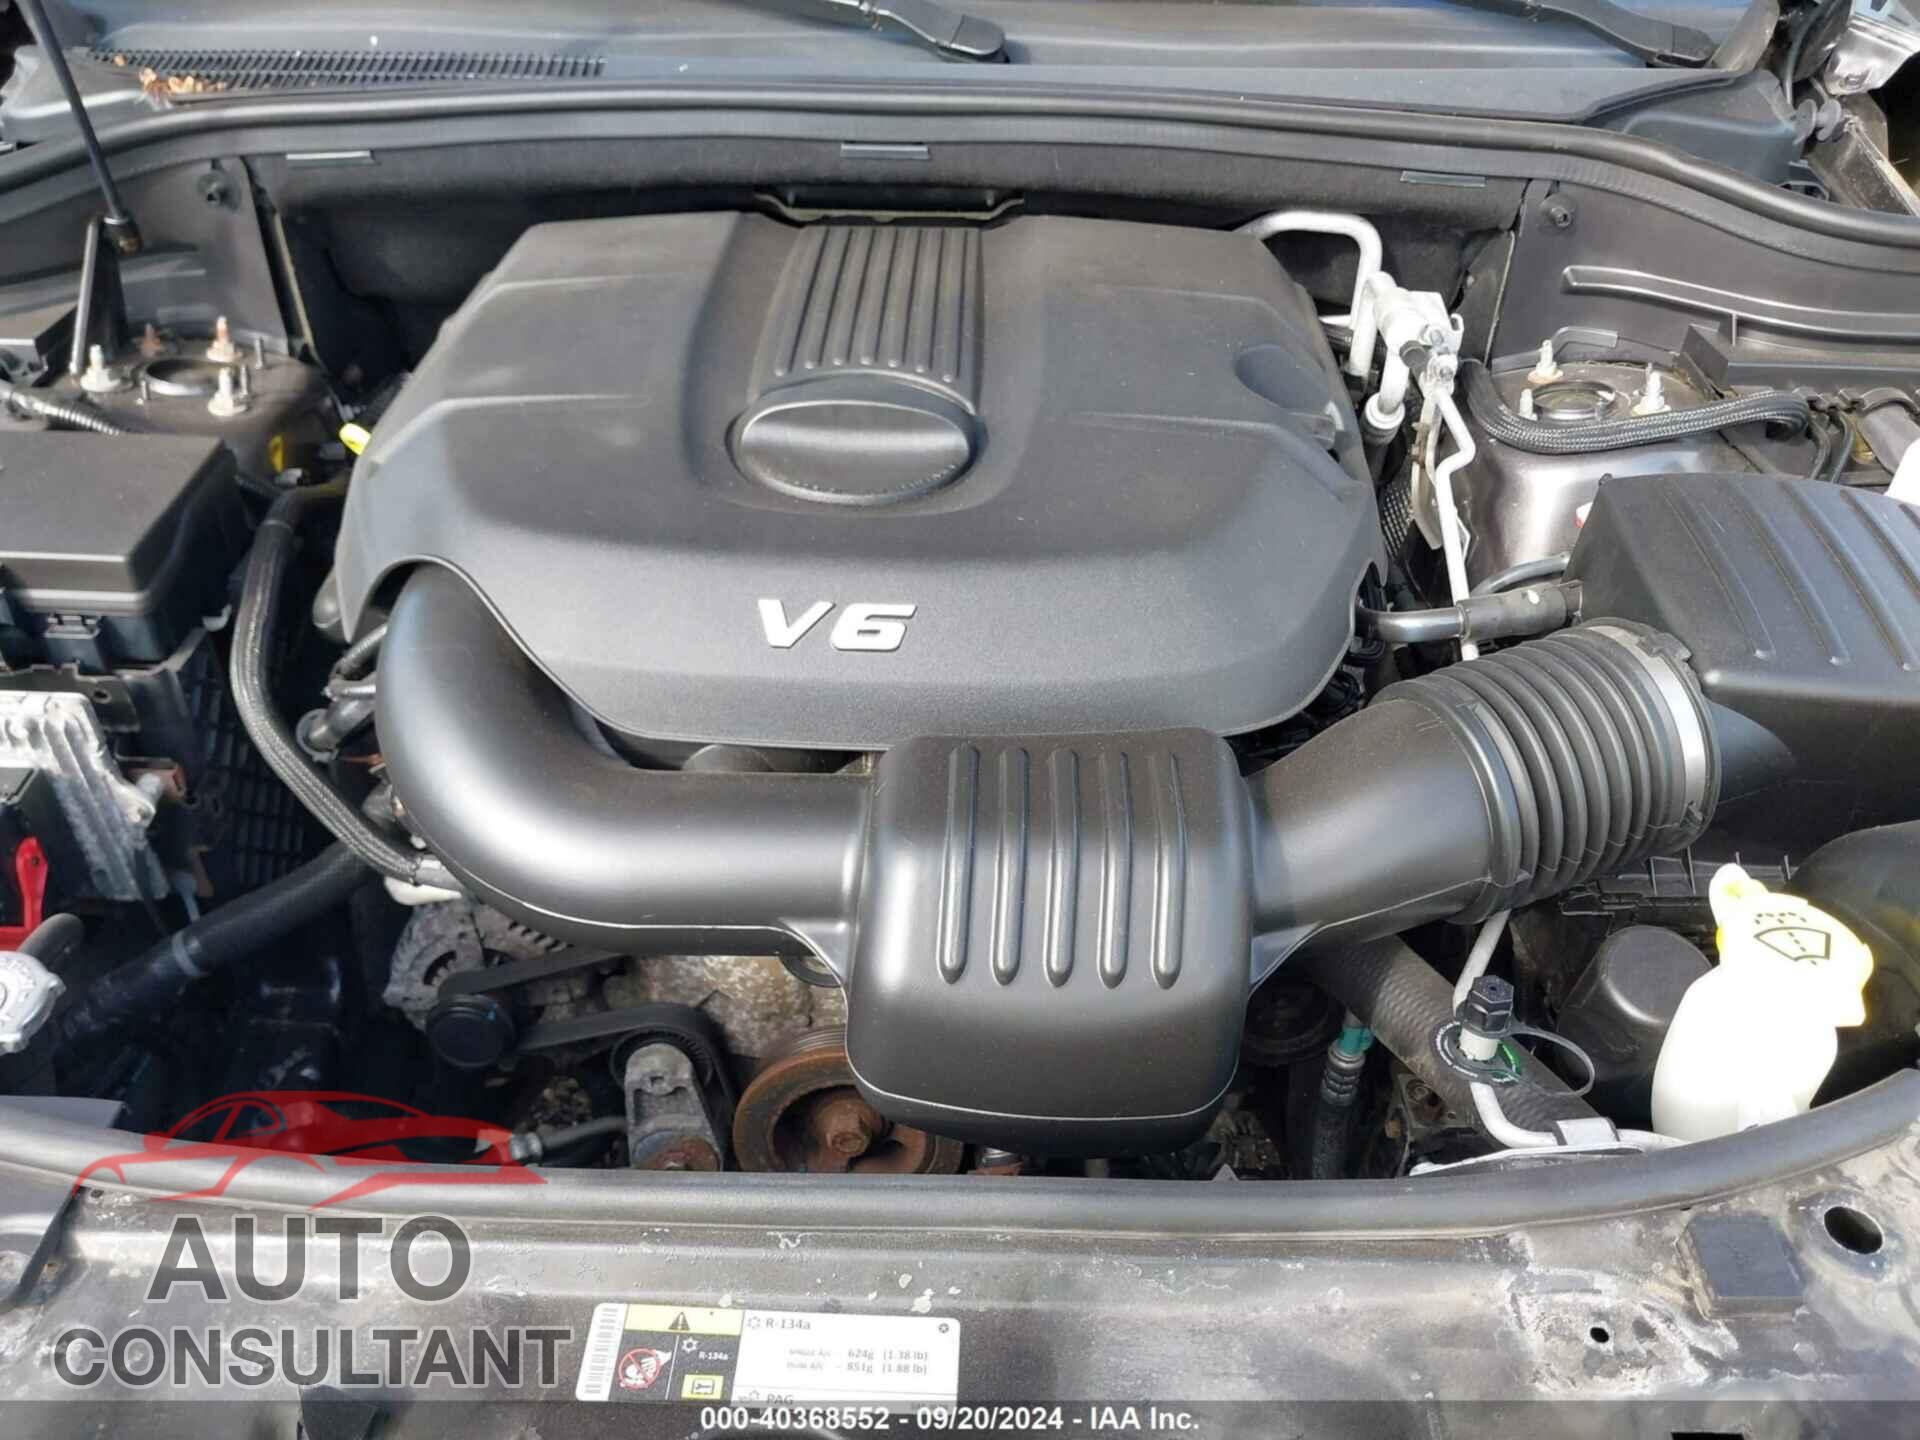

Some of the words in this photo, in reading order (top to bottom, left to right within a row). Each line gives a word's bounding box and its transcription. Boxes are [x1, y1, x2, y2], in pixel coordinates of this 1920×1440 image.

[757, 598, 918, 651] V6
[765, 1317, 812, 1331] R-134a
[847, 1347, 875, 1361] 624g
[765, 1392, 795, 1405] PAG
